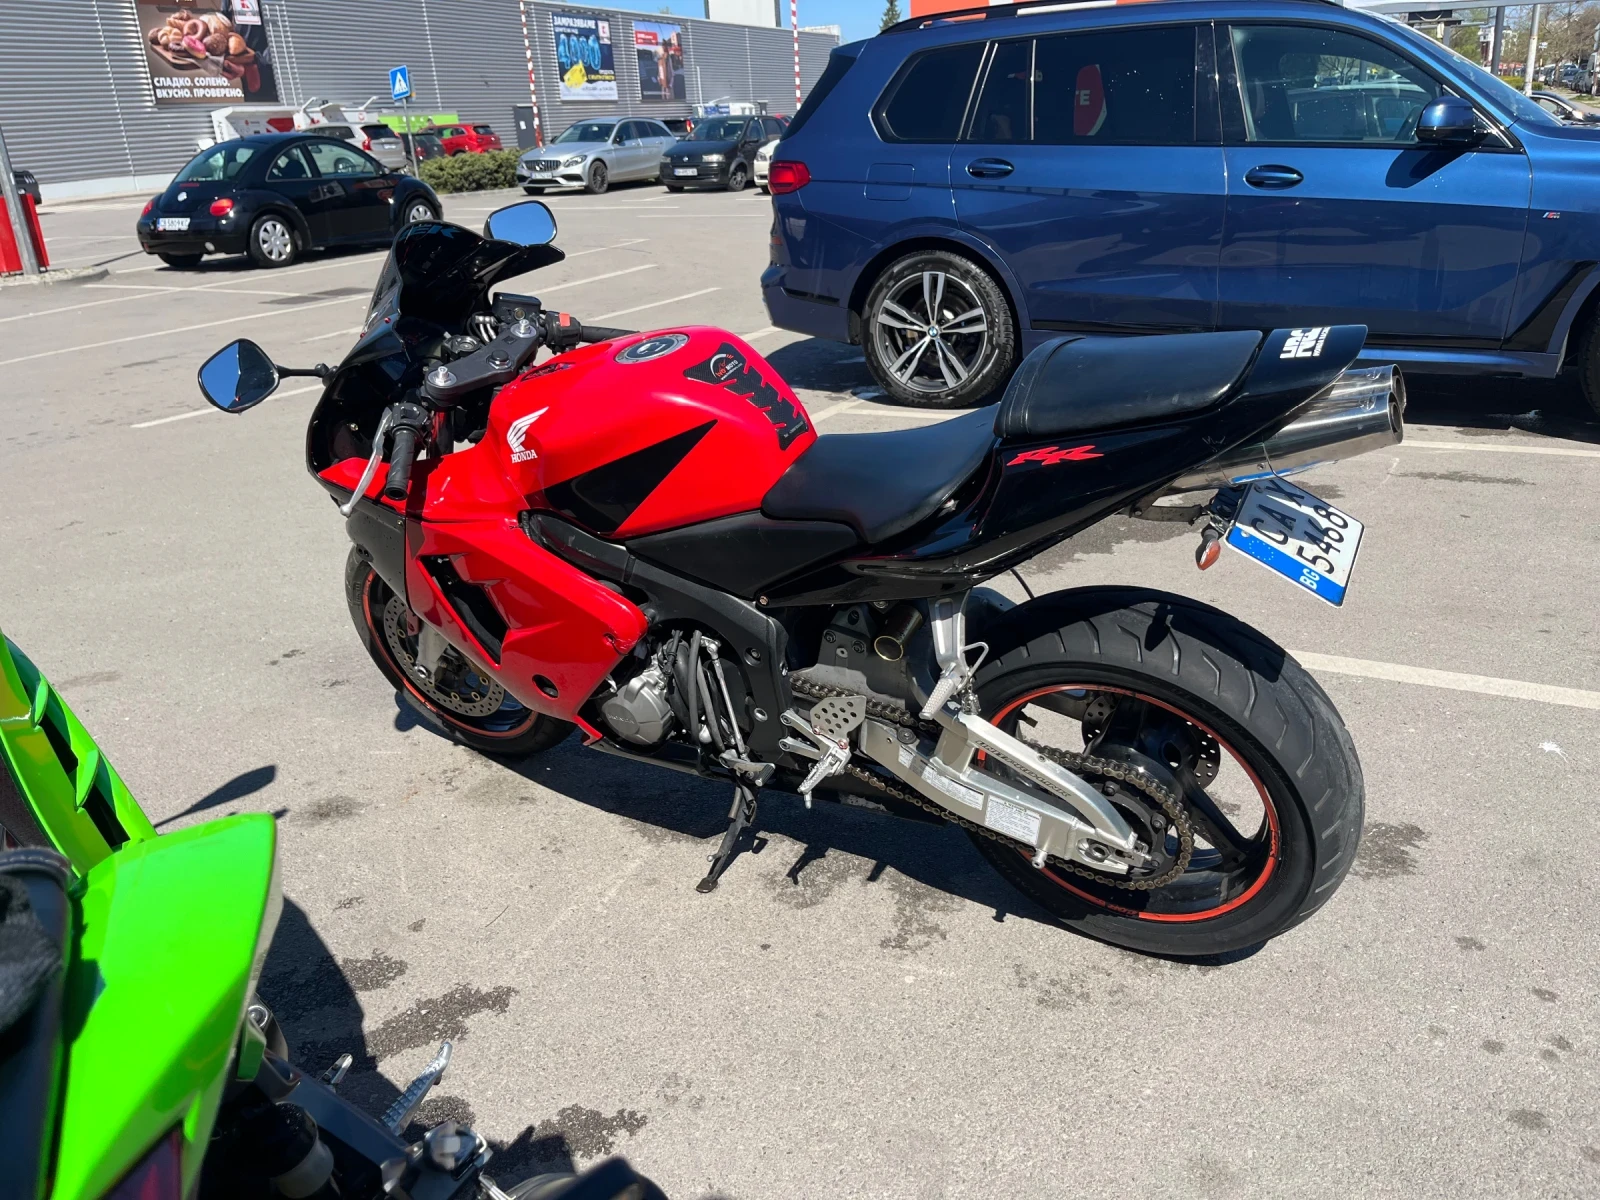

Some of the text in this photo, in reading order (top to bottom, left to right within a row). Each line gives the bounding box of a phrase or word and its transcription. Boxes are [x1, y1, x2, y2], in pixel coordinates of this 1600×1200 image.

[153, 77, 230, 88] СЛАДКО. СОЛЕНО.
[156, 88, 244, 99] ВКУСНО. ПРОВЕРЕНО.
[510, 449, 538, 464] HONDA
[1251, 479, 1305, 545] CA X
[1295, 504, 1349, 575] 5468
[1299, 567, 1321, 590] BG
